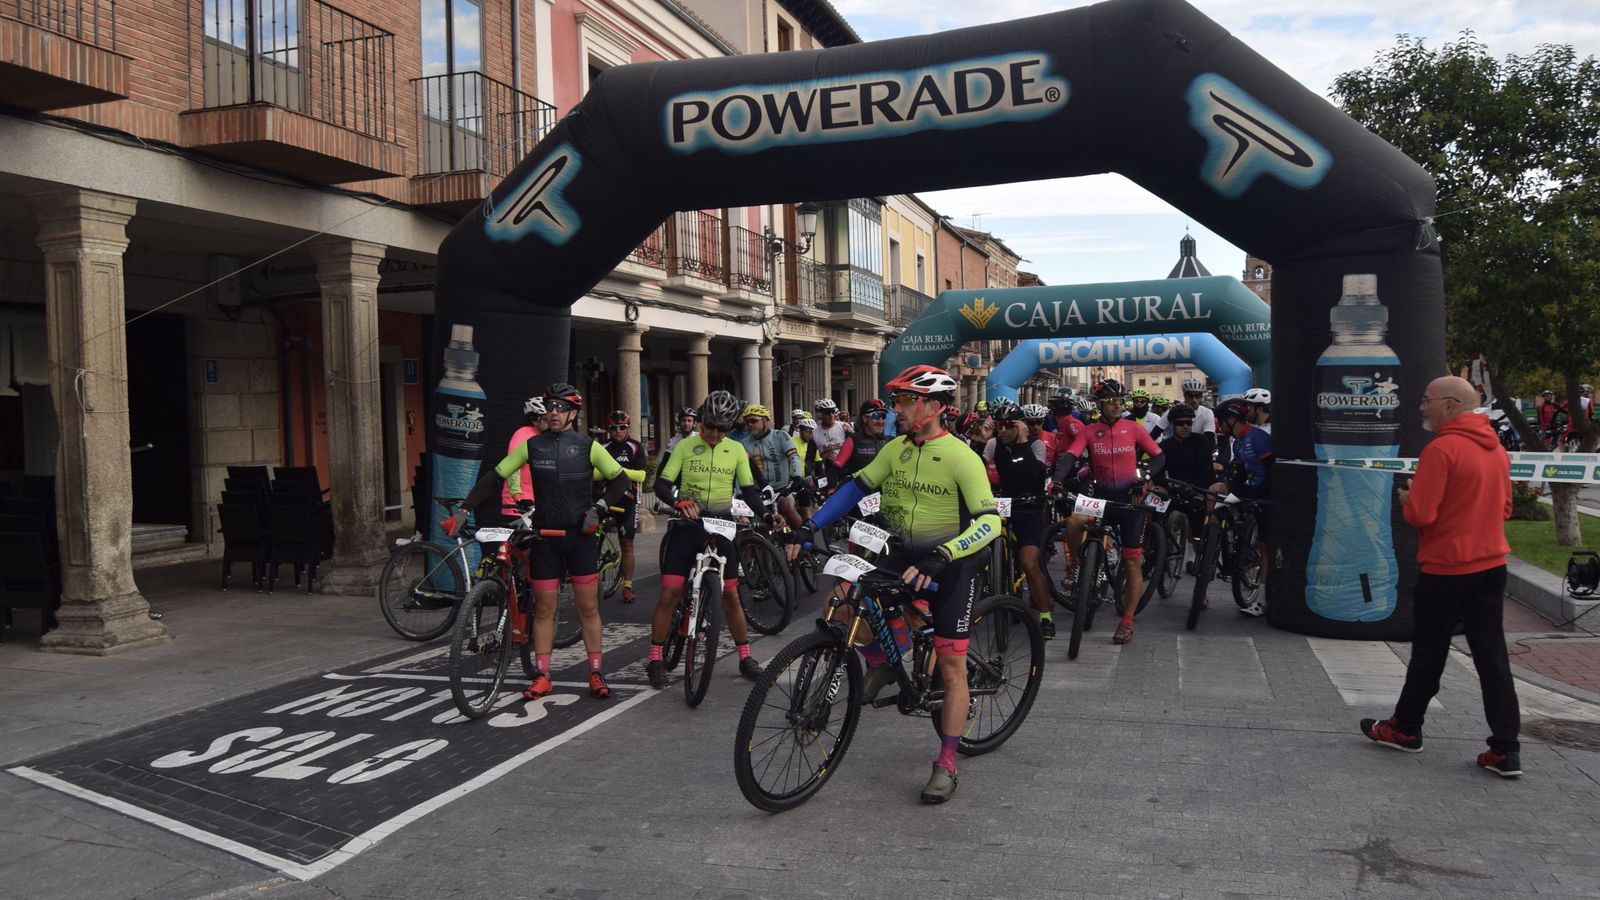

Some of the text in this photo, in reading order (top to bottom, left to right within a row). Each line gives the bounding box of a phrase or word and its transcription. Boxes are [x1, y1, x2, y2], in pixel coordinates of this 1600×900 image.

[1004, 292, 1212, 332] CAJA RURAL
[1219, 322, 1271, 335] CAJA RURA
[902, 334, 956, 345] CAJA RURAL
[911, 343, 955, 351] SALAMANCA
[1038, 335, 1191, 365] DECATHLON
[863, 497, 879, 508] 132
[1081, 500, 1100, 509] 178
[1149, 496, 1166, 507] 105
[958, 523, 992, 551] BIKE10
[956, 618, 965, 633] BTT
[263, 684, 581, 728] MOTOS
[150, 726, 450, 785] SOLO
